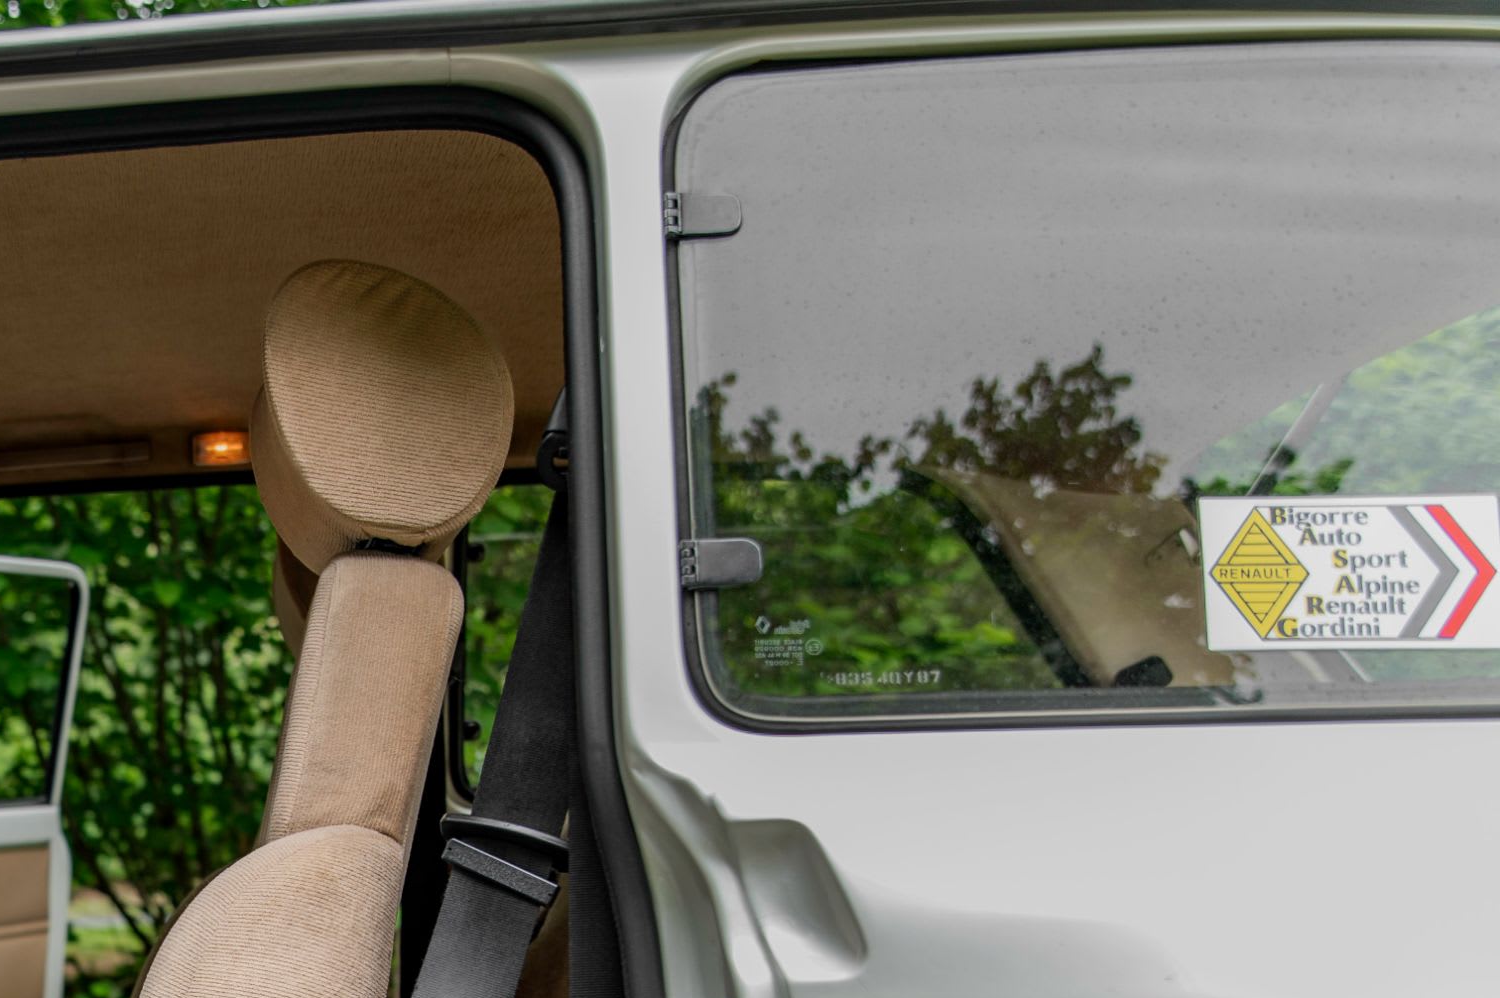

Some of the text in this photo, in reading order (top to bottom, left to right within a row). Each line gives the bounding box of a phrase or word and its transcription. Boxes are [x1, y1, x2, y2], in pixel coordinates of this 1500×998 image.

[1269, 506, 1368, 530] Bigorre
[1298, 527, 1362, 546] Auto
[1332, 550, 1408, 573] Sport
[1219, 568, 1291, 579] RENAULT
[1335, 574, 1420, 598] Alpine
[1305, 596, 1406, 615] Renault
[1275, 618, 1381, 638] Gordini
